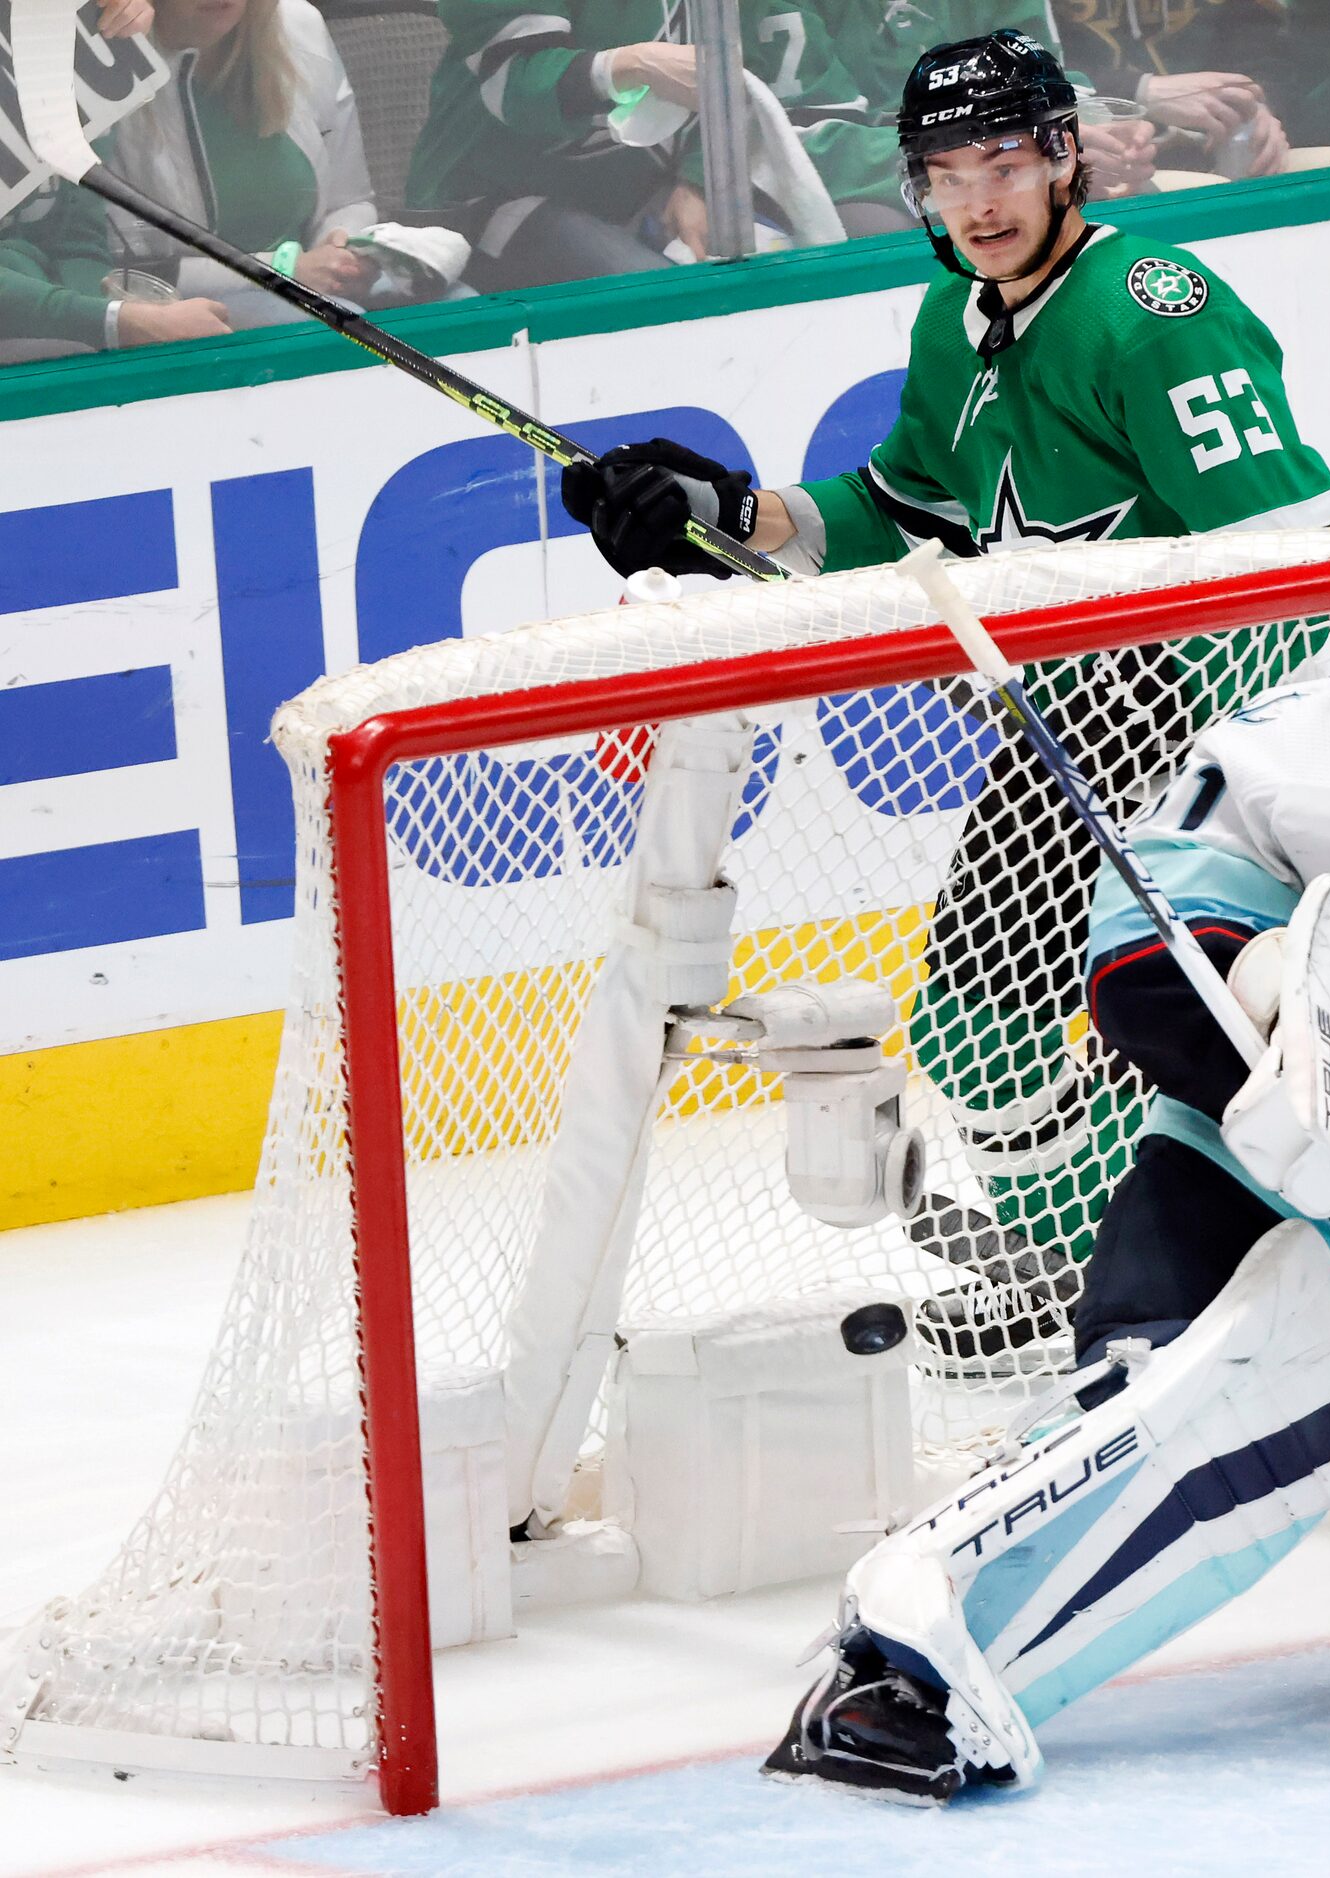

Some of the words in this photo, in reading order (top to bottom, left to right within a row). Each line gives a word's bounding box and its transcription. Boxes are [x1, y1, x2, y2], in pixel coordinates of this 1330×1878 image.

[928, 65, 961, 91] 53
[921, 104, 974, 126] CCM
[1150, 286, 1203, 312] STARS
[1167, 368, 1284, 474] 53
[743, 495, 754, 533] CCM
[950, 1425, 1139, 1557] TRUE
